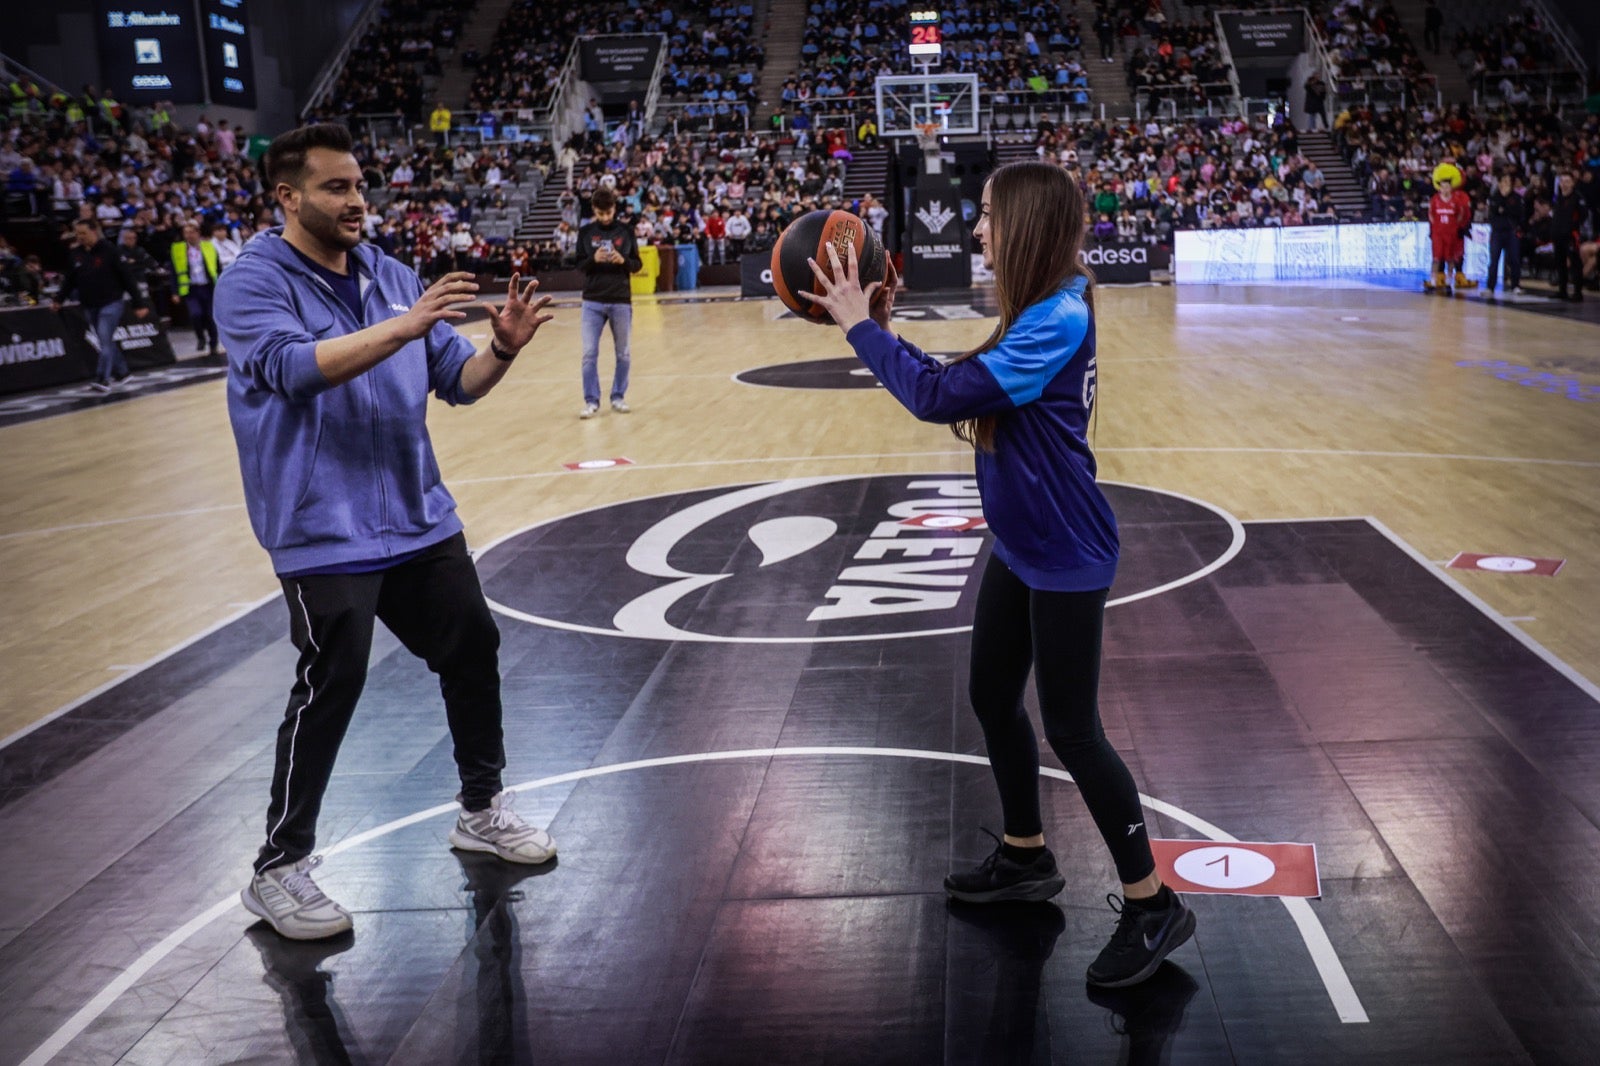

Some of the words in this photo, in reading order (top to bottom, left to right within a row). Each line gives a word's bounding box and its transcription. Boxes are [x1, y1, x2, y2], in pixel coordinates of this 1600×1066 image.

[911, 26, 938, 44] 24
[1077, 244, 1148, 265] ndesa
[1205, 854, 1230, 878] 1
